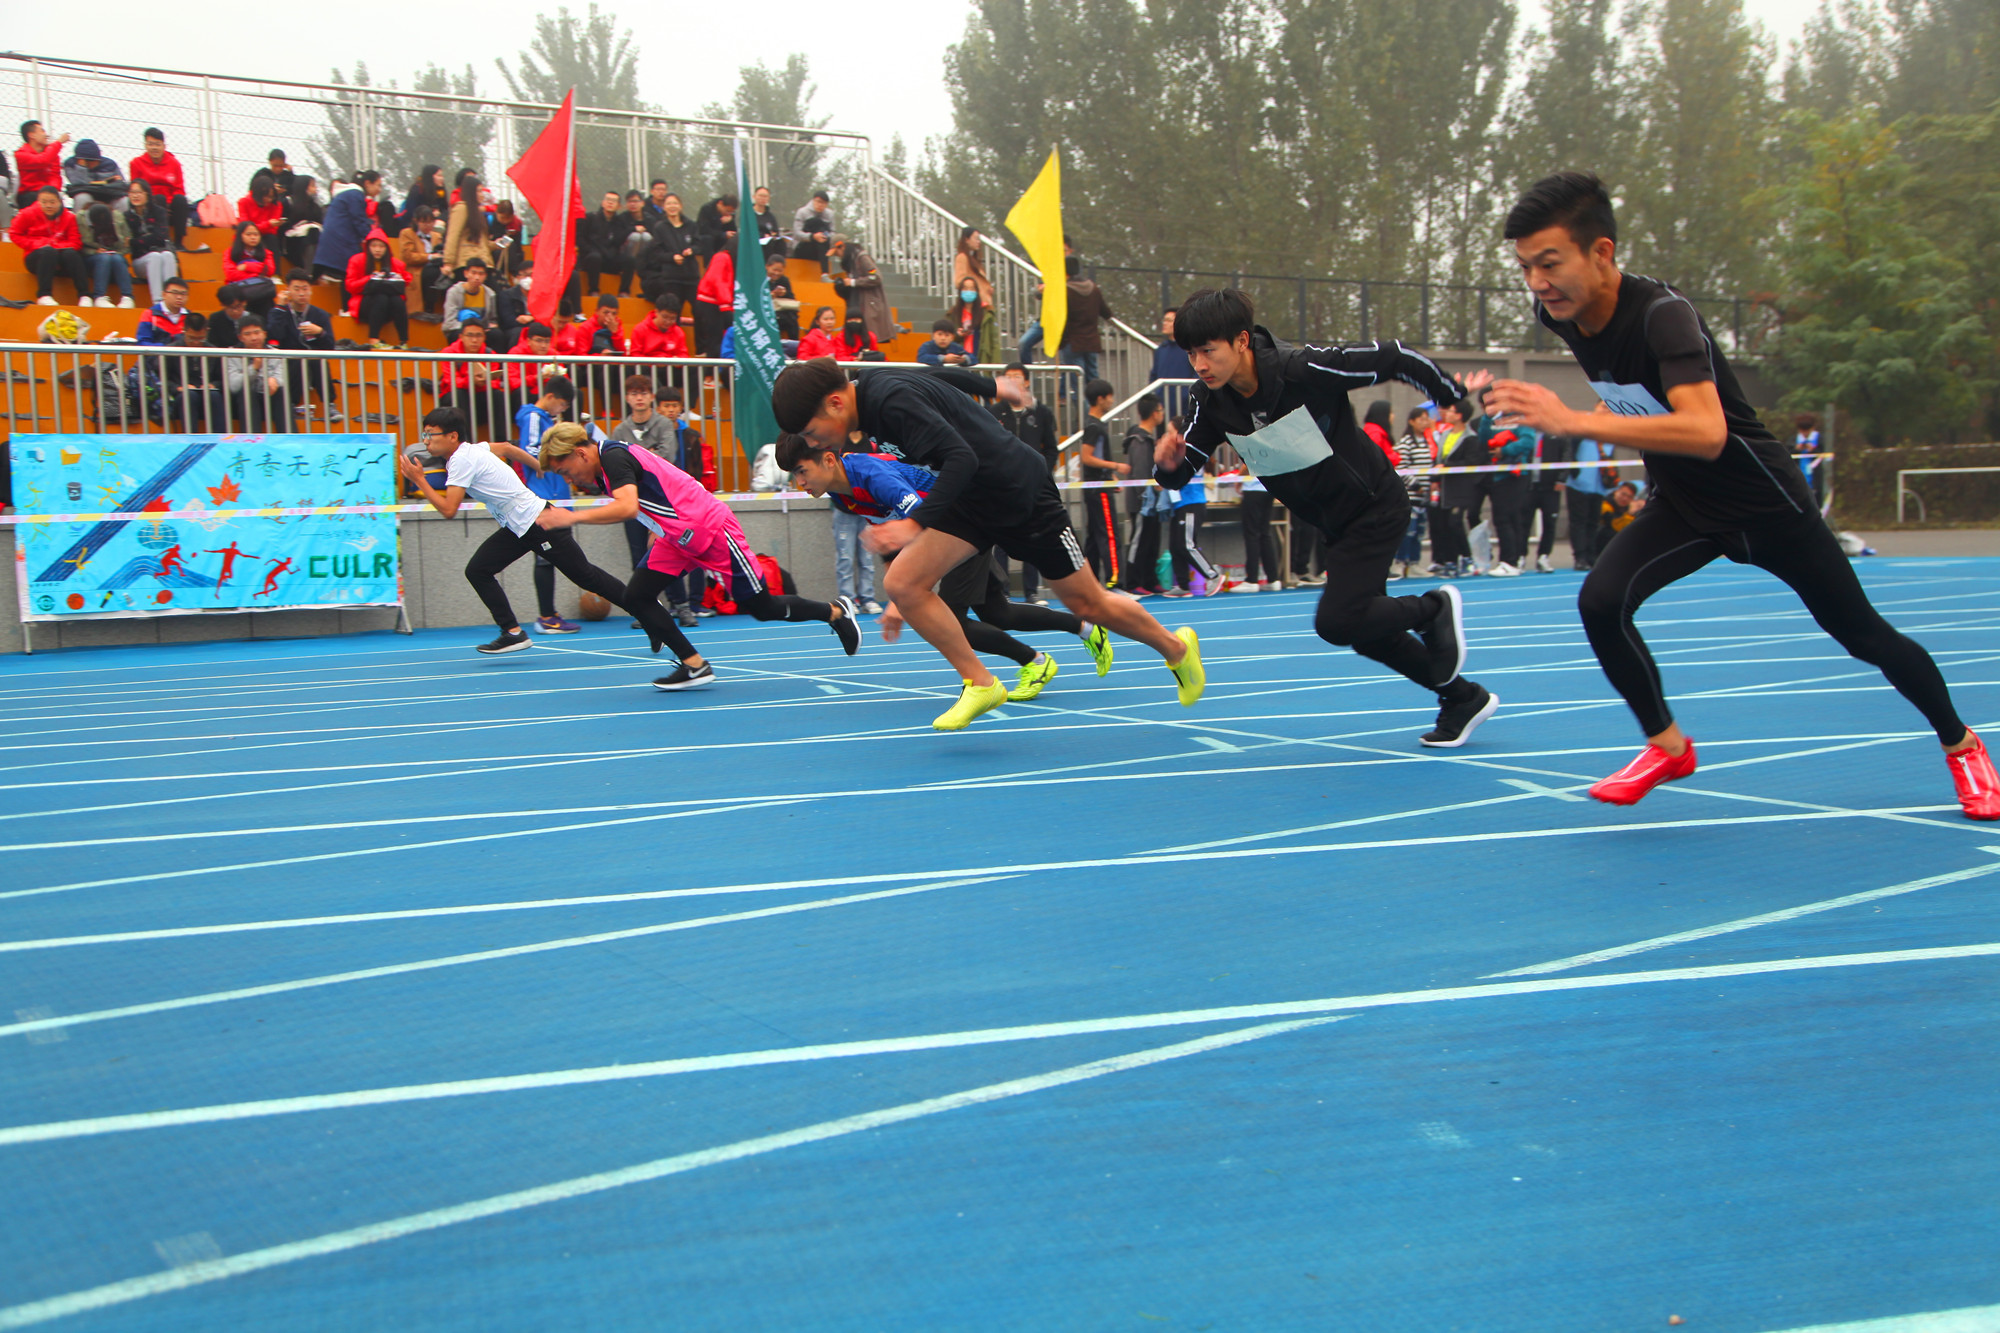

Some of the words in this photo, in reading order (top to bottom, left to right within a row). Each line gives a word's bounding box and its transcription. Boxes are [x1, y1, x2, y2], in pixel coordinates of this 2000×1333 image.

[226, 450, 343, 480] 青春无畏
[896, 493, 917, 510] beko
[309, 552, 394, 578] CULR
